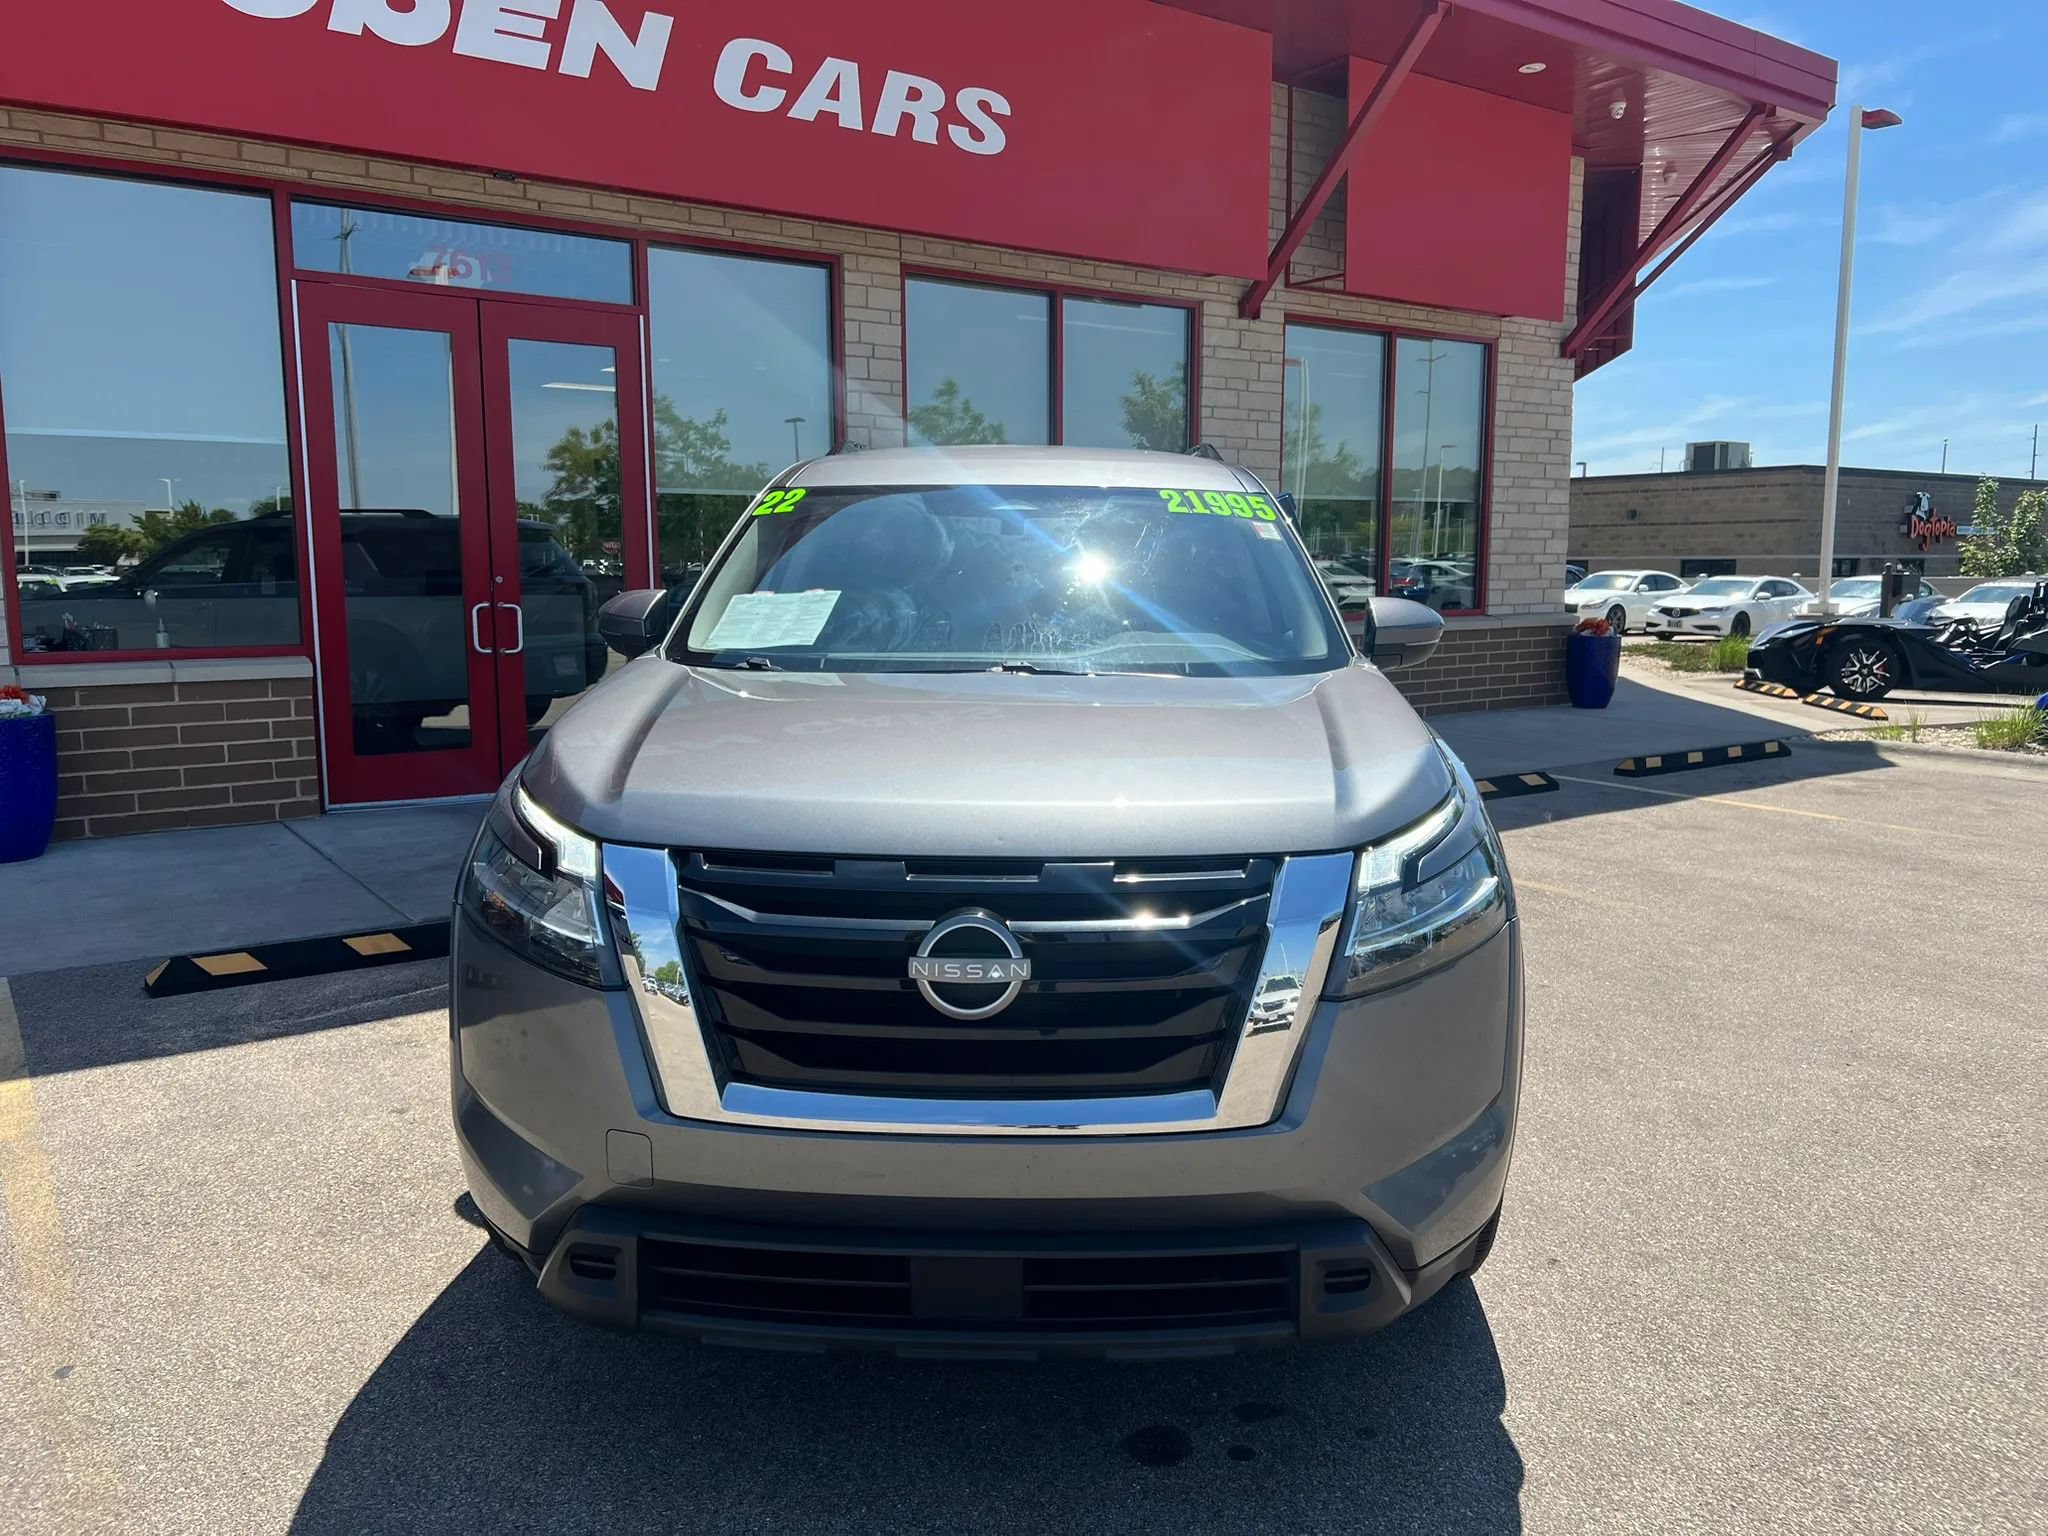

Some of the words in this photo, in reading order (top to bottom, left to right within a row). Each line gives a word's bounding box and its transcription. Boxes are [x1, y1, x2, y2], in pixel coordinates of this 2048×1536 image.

[713, 38, 1012, 156] CARS
[752, 488, 807, 516] 22
[1159, 489, 1277, 521] 21995
[1910, 508, 1957, 551] Dogtopia
[911, 961, 1028, 979] NISSAN
